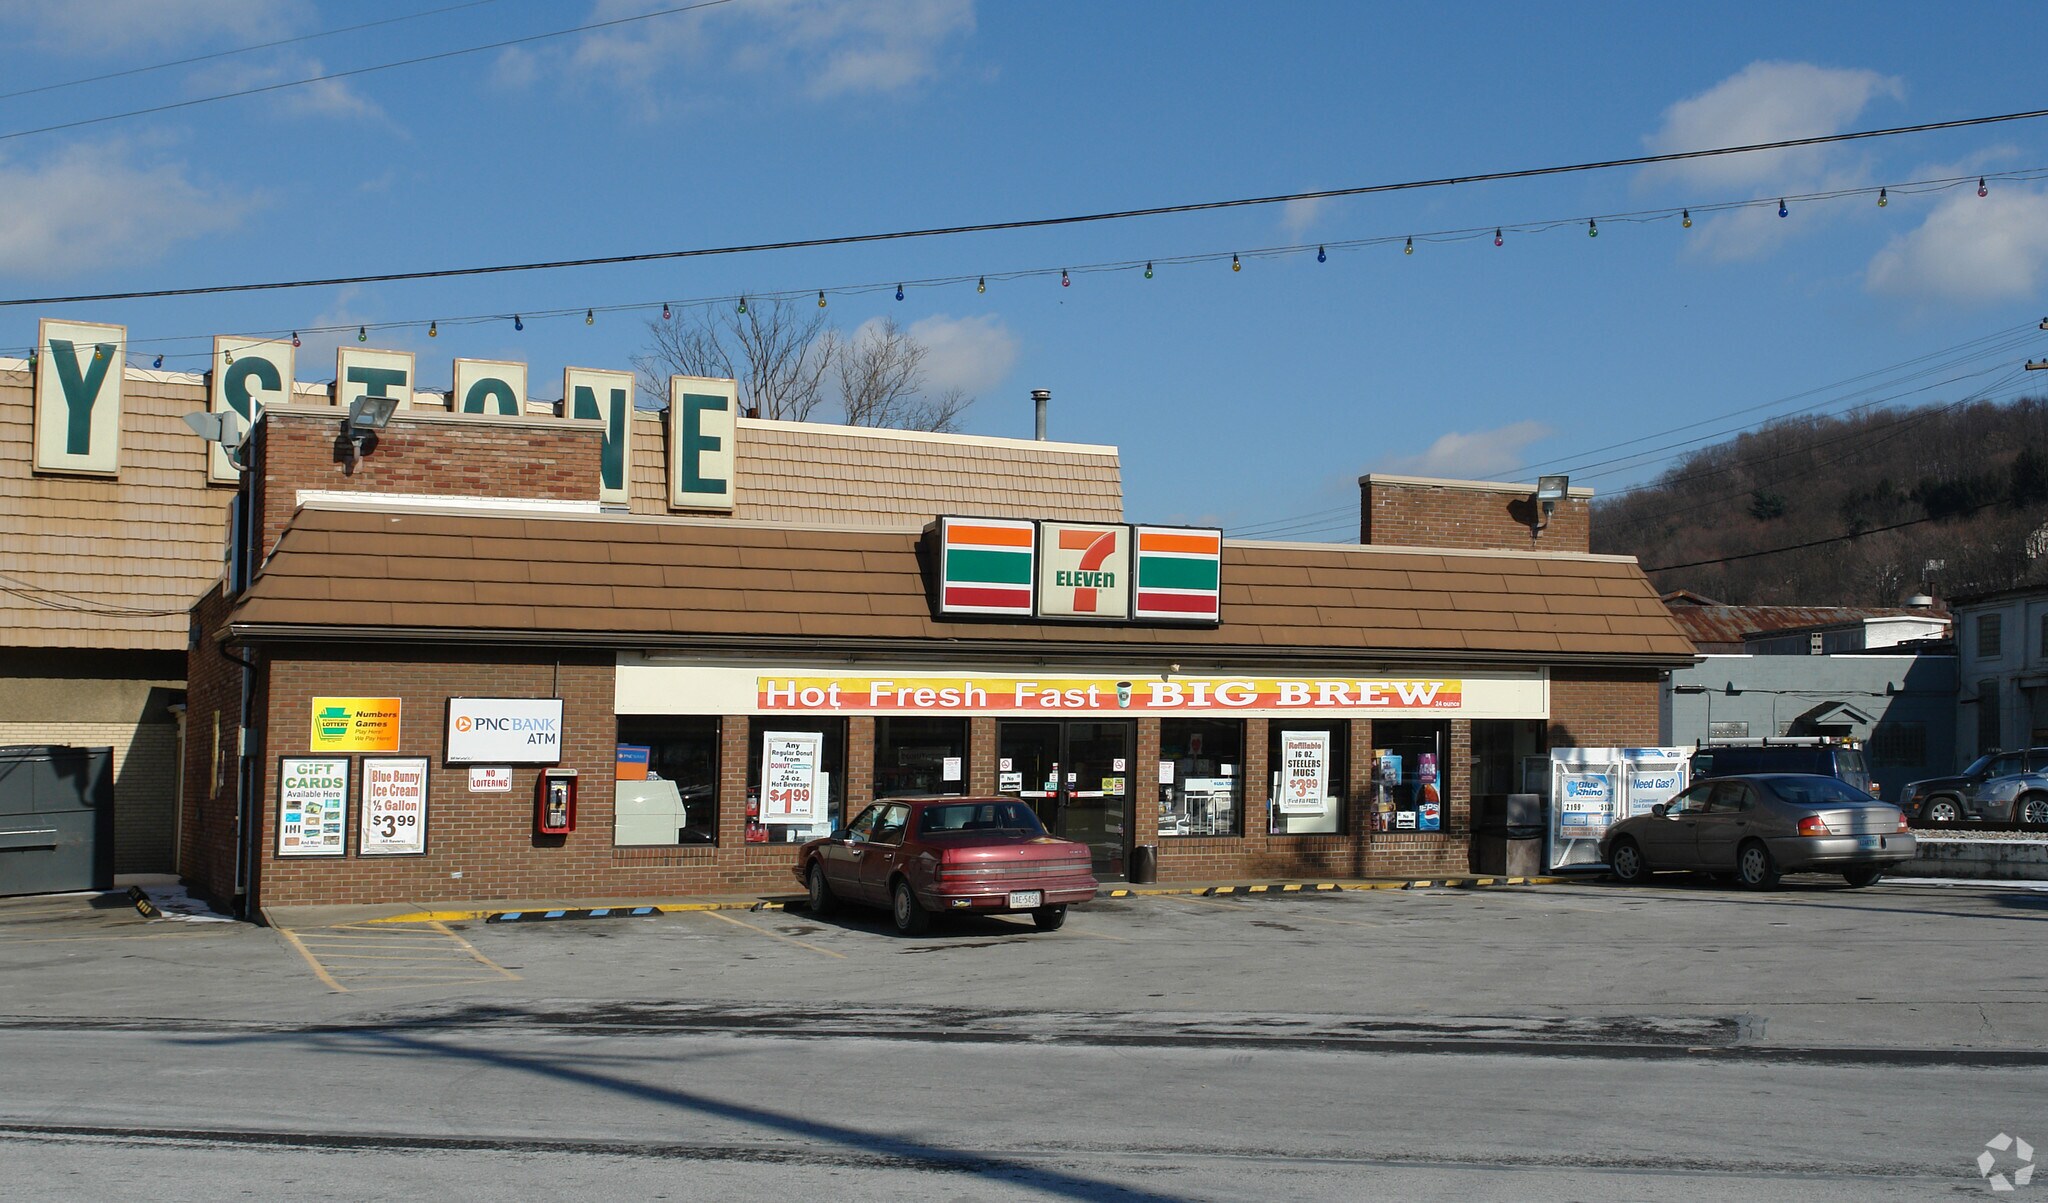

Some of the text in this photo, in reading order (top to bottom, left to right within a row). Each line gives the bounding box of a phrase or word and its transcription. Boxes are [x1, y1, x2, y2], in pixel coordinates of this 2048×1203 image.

[1059, 529, 1116, 612] 7
[766, 680, 1444, 708] Hot Fresh Fast BIG BREW
[474, 718, 556, 731] PNC BANK
[527, 733, 556, 744] ATM
[285, 777, 344, 788] CARDS
[372, 770, 420, 785] Blue Bunny
[1633, 778, 1674, 789] Need Gas?
[373, 784, 418, 796] Ice Cream
[385, 800, 417, 811] Gallon
